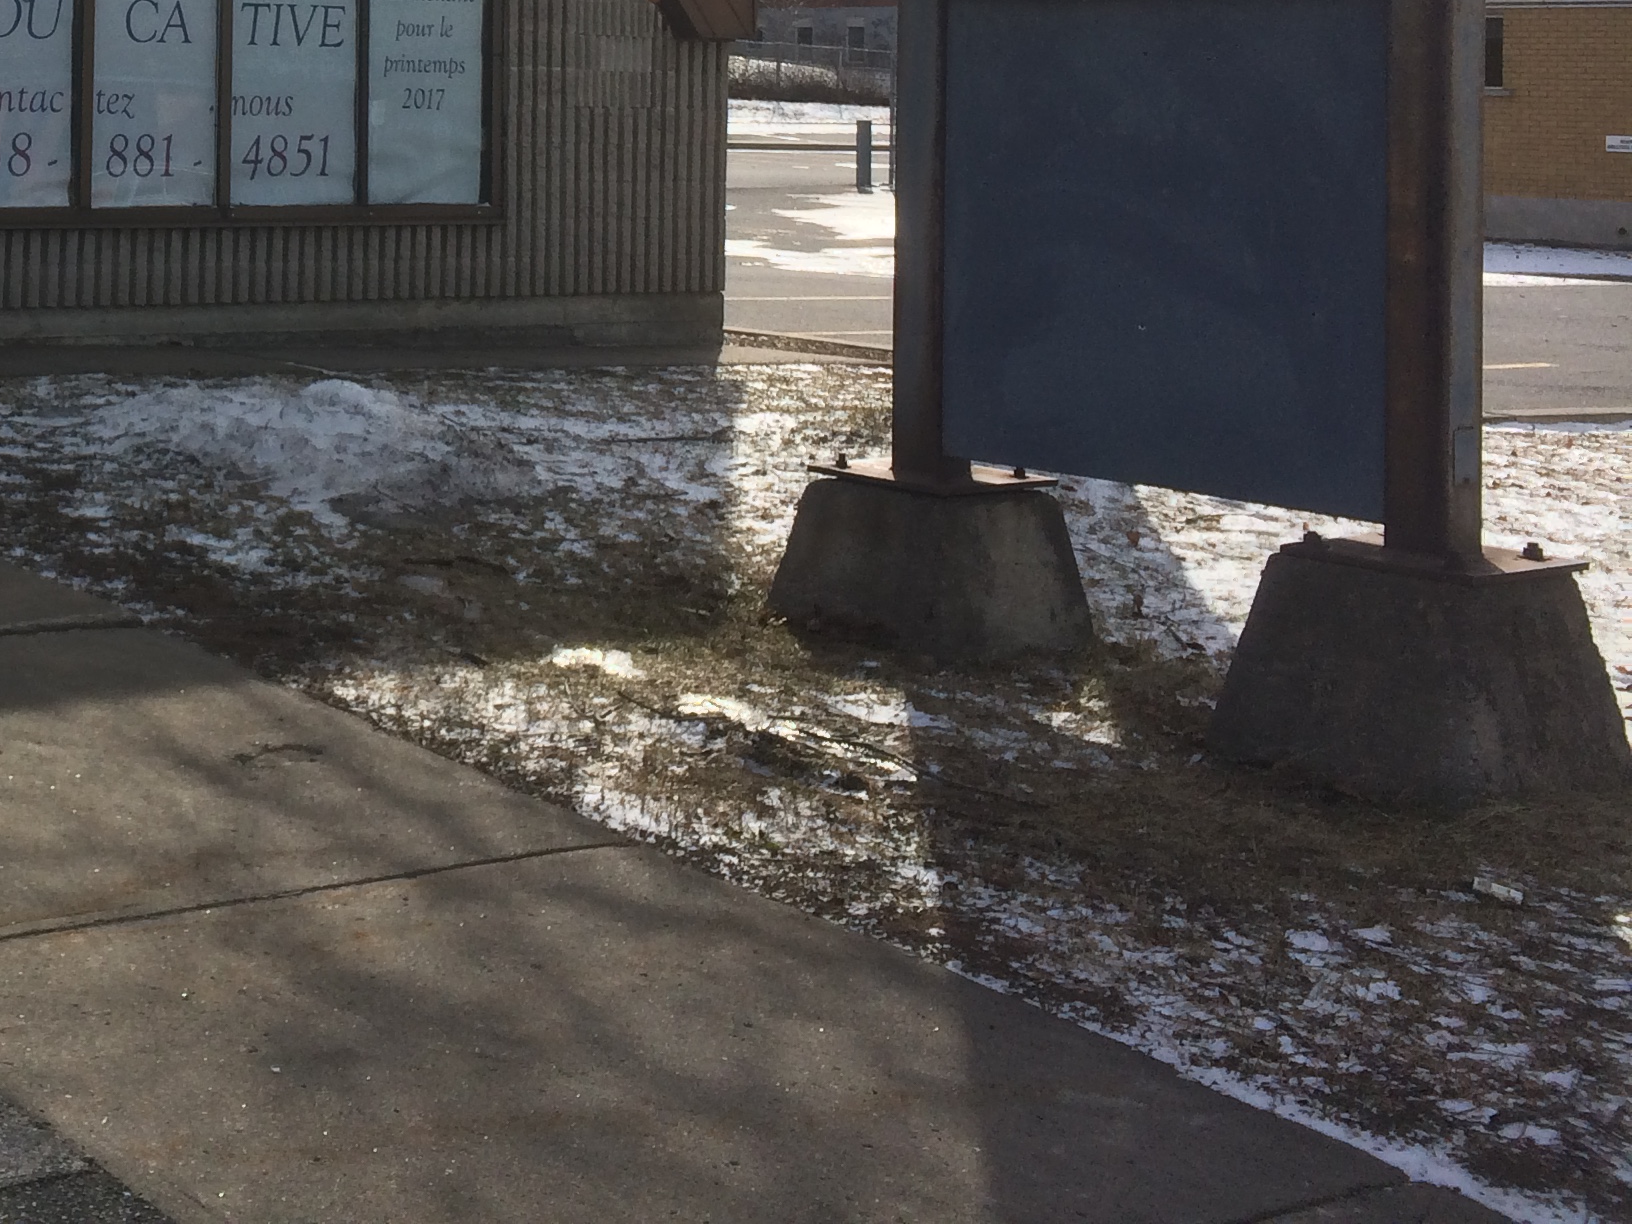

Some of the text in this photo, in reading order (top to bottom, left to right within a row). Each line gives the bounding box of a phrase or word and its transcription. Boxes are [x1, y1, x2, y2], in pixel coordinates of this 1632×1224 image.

[394, 15, 454, 42] pour le
[382, 53, 467, 79] printemps
[401, 86, 446, 111] 2017
[241, 133, 332, 181] 4851
